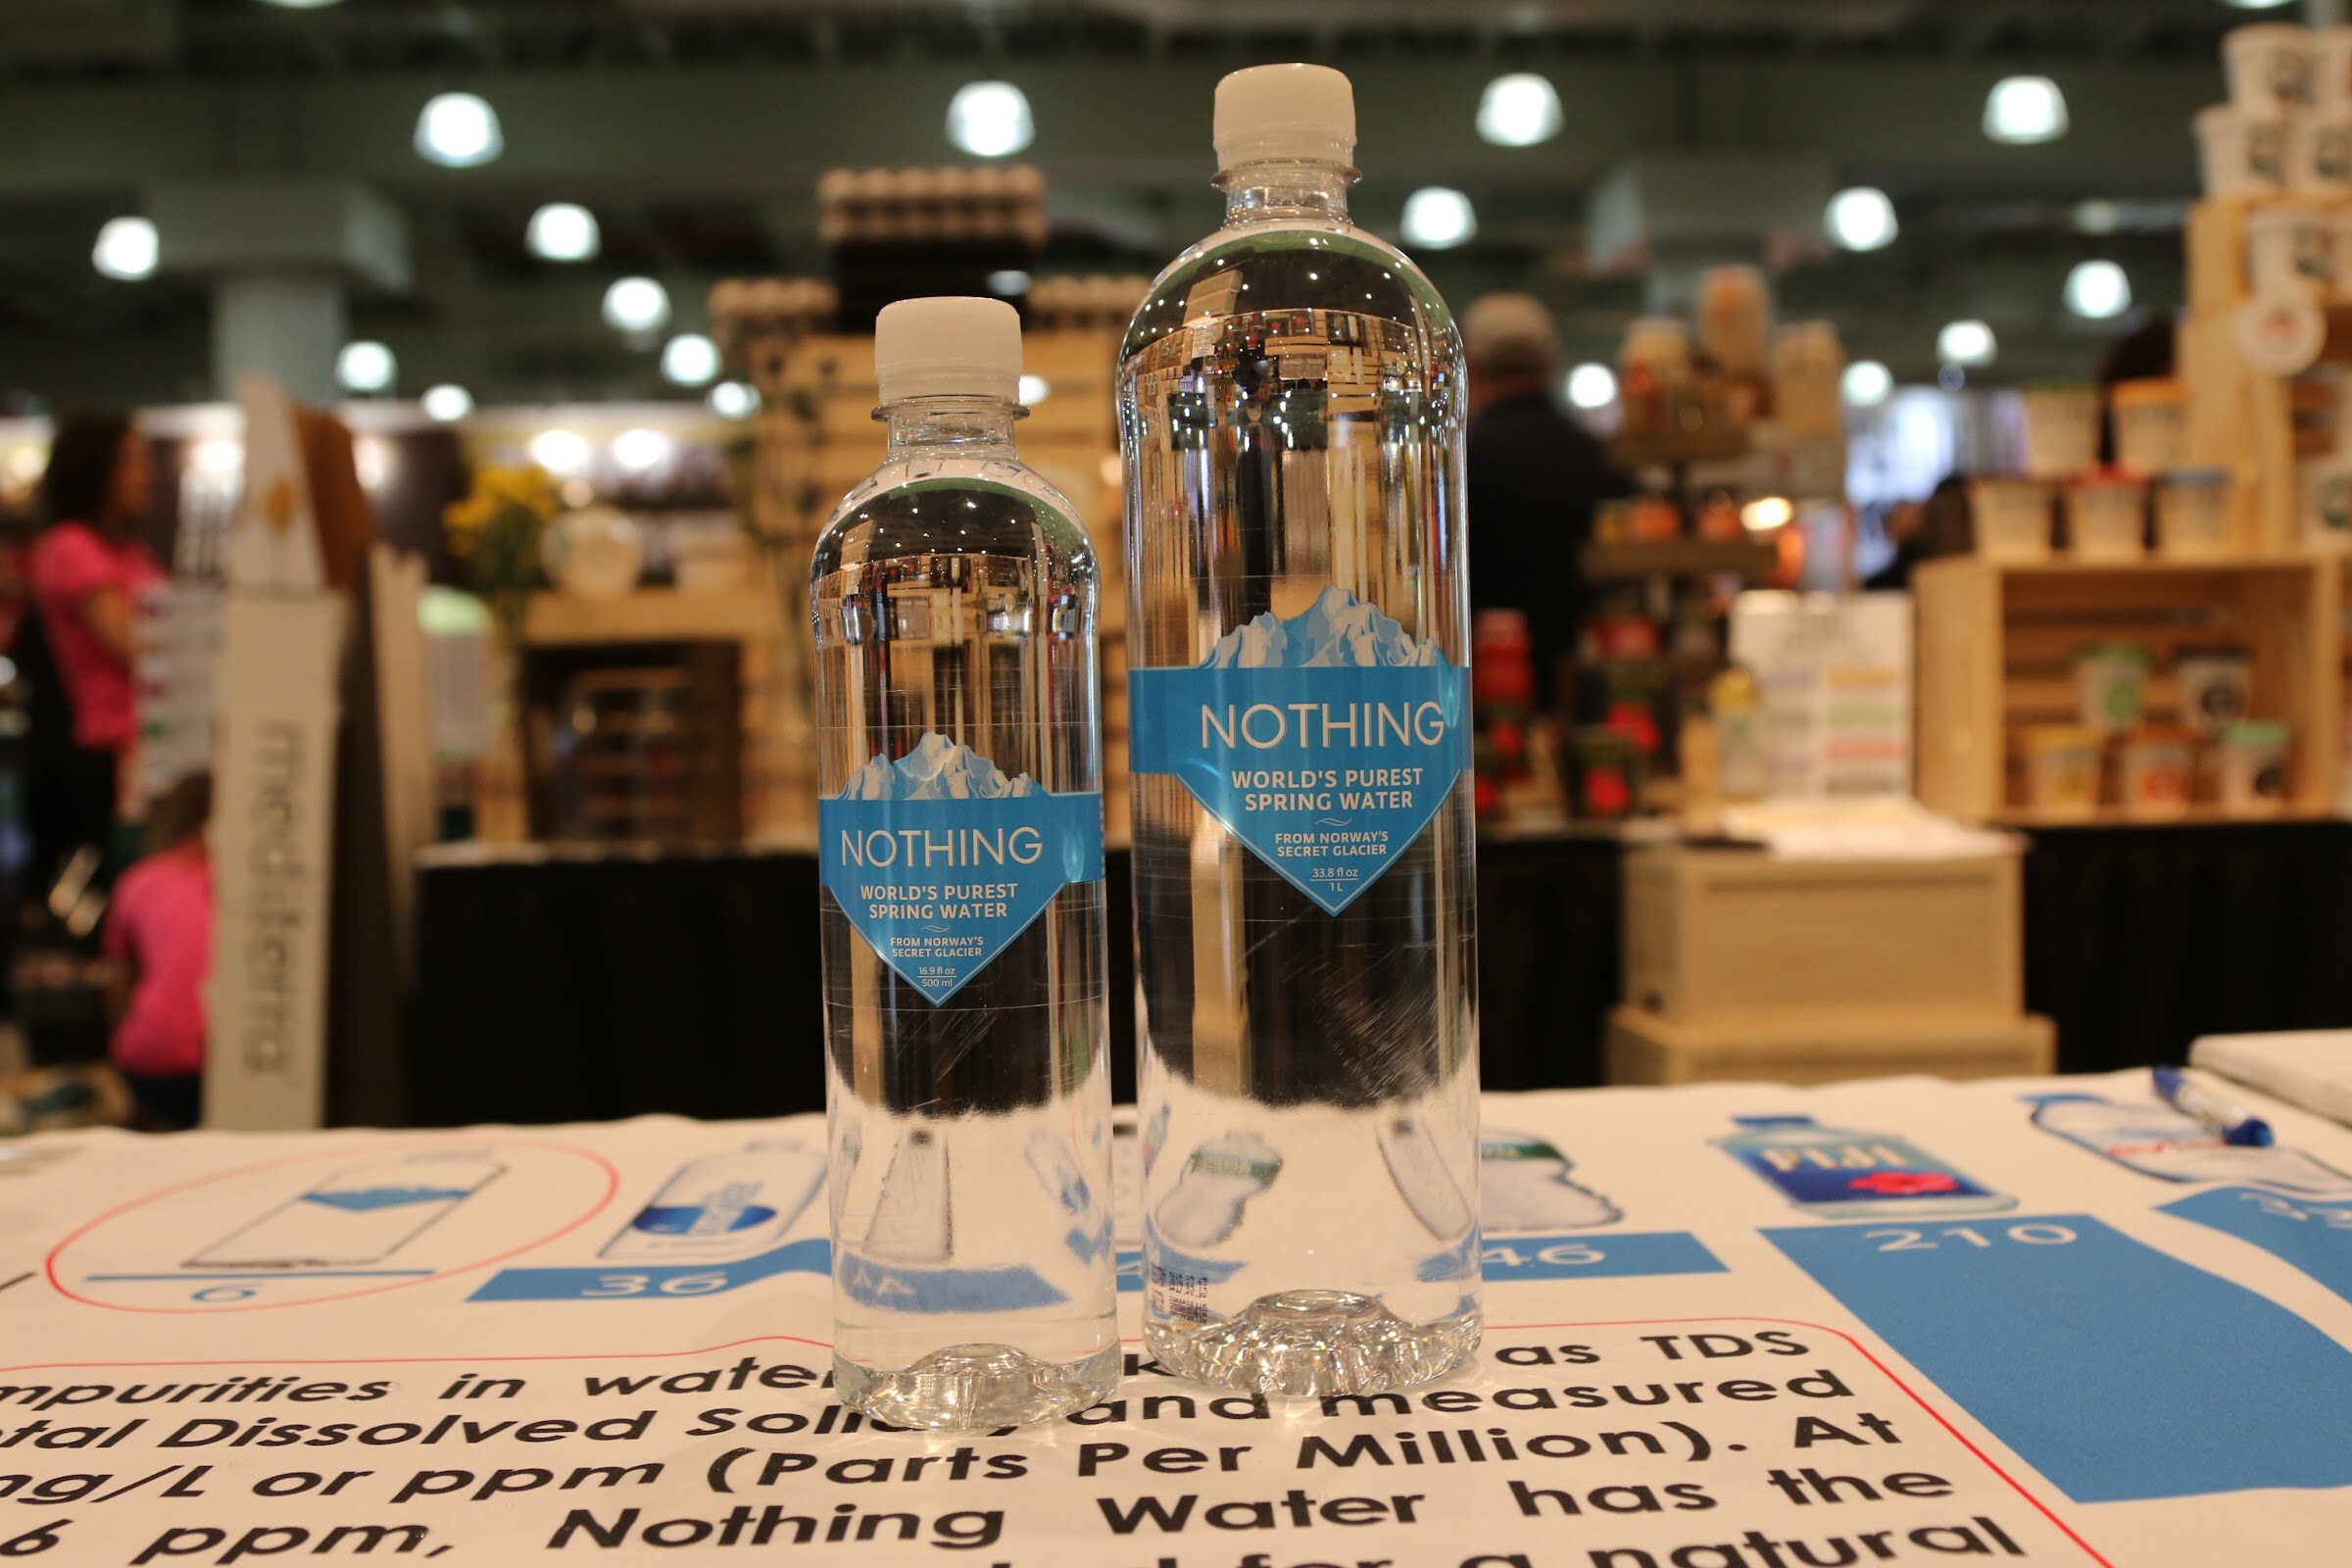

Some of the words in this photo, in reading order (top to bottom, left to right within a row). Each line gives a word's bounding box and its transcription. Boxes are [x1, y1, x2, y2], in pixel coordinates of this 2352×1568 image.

[1201, 701, 1446, 749] NOTHING
[1232, 769, 1338, 789] WORLD'S
[1346, 767, 1424, 788] PUREST
[1245, 791, 1332, 811] SPRING
[1340, 790, 1414, 809] WATER
[840, 826, 1044, 867] NOTHING
[1275, 832, 1315, 845] FROM
[1277, 846, 1329, 858] SECRET
[1332, 844, 1388, 857] GLACIER
[1312, 867, 1335, 878] 33.8
[1337, 866, 1344, 877] fl
[1346, 868, 1358, 877] oz
[859, 884, 938, 902] WORLD'S
[944, 882, 1018, 900] PUREST
[868, 903, 934, 919] SPRING
[940, 902, 1007, 918] WATER
[890, 937, 921, 948] FROM
[892, 948, 932, 958] SECRET
[934, 946, 983, 957] GLACIER
[918, 966, 936, 975] 16.9
[937, 965, 943, 974] fl
[942, 978, 953, 987] ml
[1864, 1223, 2078, 1252] 210
[189, 1281, 263, 1303] 6
[581, 1271, 728, 1297] 36
[438, 1373, 525, 1399] in
[1495, 1346, 1600, 1365] as
[1641, 1331, 1809, 1360] TDS
[158, 1410, 658, 1447] Dissolved
[1319, 1370, 1854, 1417] measured
[253, 1470, 374, 1496] or
[391, 1462, 664, 1503] ppm
[707, 1446, 1028, 1494] (Parts
[1078, 1443, 1251, 1477] Per
[1297, 1427, 1747, 1469] Million).
[1794, 1412, 1901, 1448] At
[0, 1518, 74, 1556] 6
[129, 1520, 451, 1565] ppm,
[547, 1503, 1004, 1549] Nothing
[1097, 1490, 1425, 1534] Water
[1507, 1481, 1717, 1516] has
[1767, 1468, 1952, 1505] the
[1588, 1516, 2026, 1568] natural
